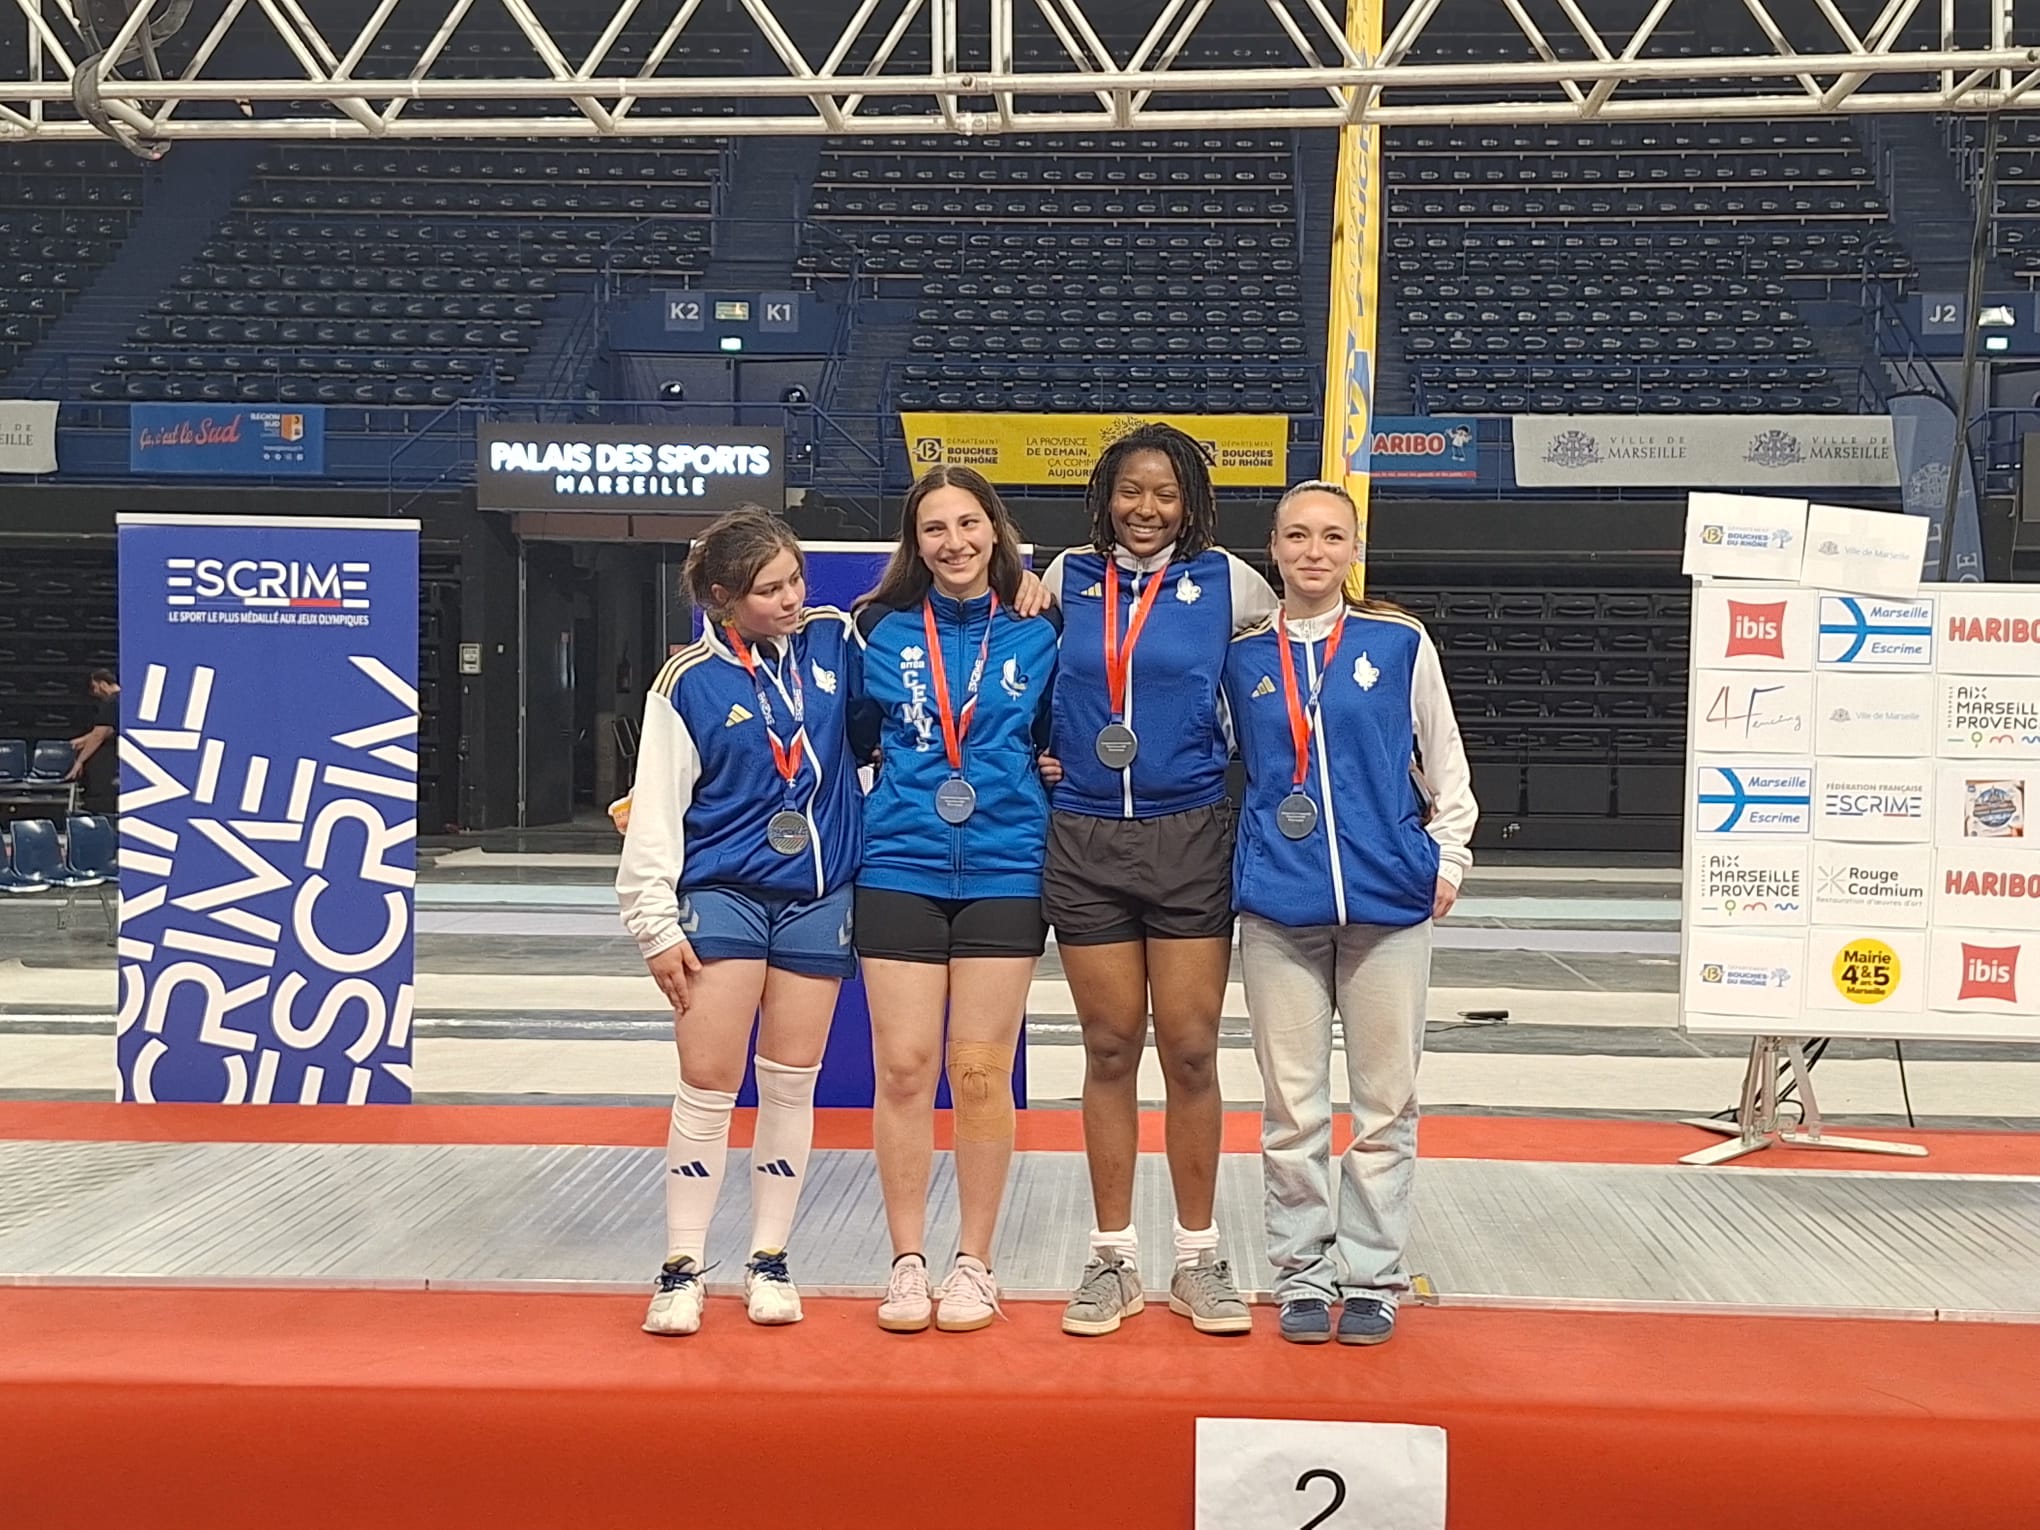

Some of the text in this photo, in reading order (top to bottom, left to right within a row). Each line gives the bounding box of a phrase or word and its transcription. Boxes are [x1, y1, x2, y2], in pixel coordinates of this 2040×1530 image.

[670, 302, 699, 320] K2
[767, 304, 791, 321] K1
[1929, 305, 1957, 323] J2
[195, 413, 241, 444] Sud
[1027, 438, 1088, 446] LA PROVENCE
[1370, 434, 1444, 453] ARIBO
[1609, 436, 1685, 444] VILLE DE
[1812, 436, 1888, 444] VILLE DE
[947, 447, 998, 455] BOUCHES
[1027, 448, 1091, 457] DE DEMAIN,
[1222, 450, 1273, 458] BOUCHES
[1608, 447, 1687, 459] MARSEILLE
[1809, 447, 1889, 460] MARSEILLE
[491, 442, 770, 475] PALAIS DES SPORTS
[964, 455, 998, 464] RHÔNE
[1048, 458, 1061, 467] ÇA
[1239, 458, 1273, 467] RHÔNE
[1048, 469, 1092, 478] AUJOUR
[555, 475, 706, 496] MARSEILLE
[1728, 532, 1768, 541] BOUCHES
[168, 559, 370, 608] ESCRIME
[169, 611, 369, 627] LE SPORT LE PLUS MÉDAILLÉ AUX JEUX OLYMPIQUES
[1870, 607, 1929, 618] Marseille
[1735, 617, 1777, 640] ibis
[1949, 616, 2040, 643] HARIBO
[1871, 642, 1922, 654] Escrime
[1748, 777, 1807, 788] Marseille
[1826, 782, 1923, 792] FÉDÉRATION FRANÇAISE
[1825, 794, 1922, 817] ESCRIME
[1749, 812, 1801, 824] Escrime
[1849, 867, 1899, 884] Rouge
[1710, 884, 1800, 897] PROVENCE
[1848, 883, 1923, 898] Cadmium
[1945, 870, 2040, 899] HARIBO
[1844, 950, 1891, 964] Mairie
[1861, 965, 1872, 978] &
[1968, 958, 2010, 983] ibis
[1295, 1468, 1346, 1530] 2
